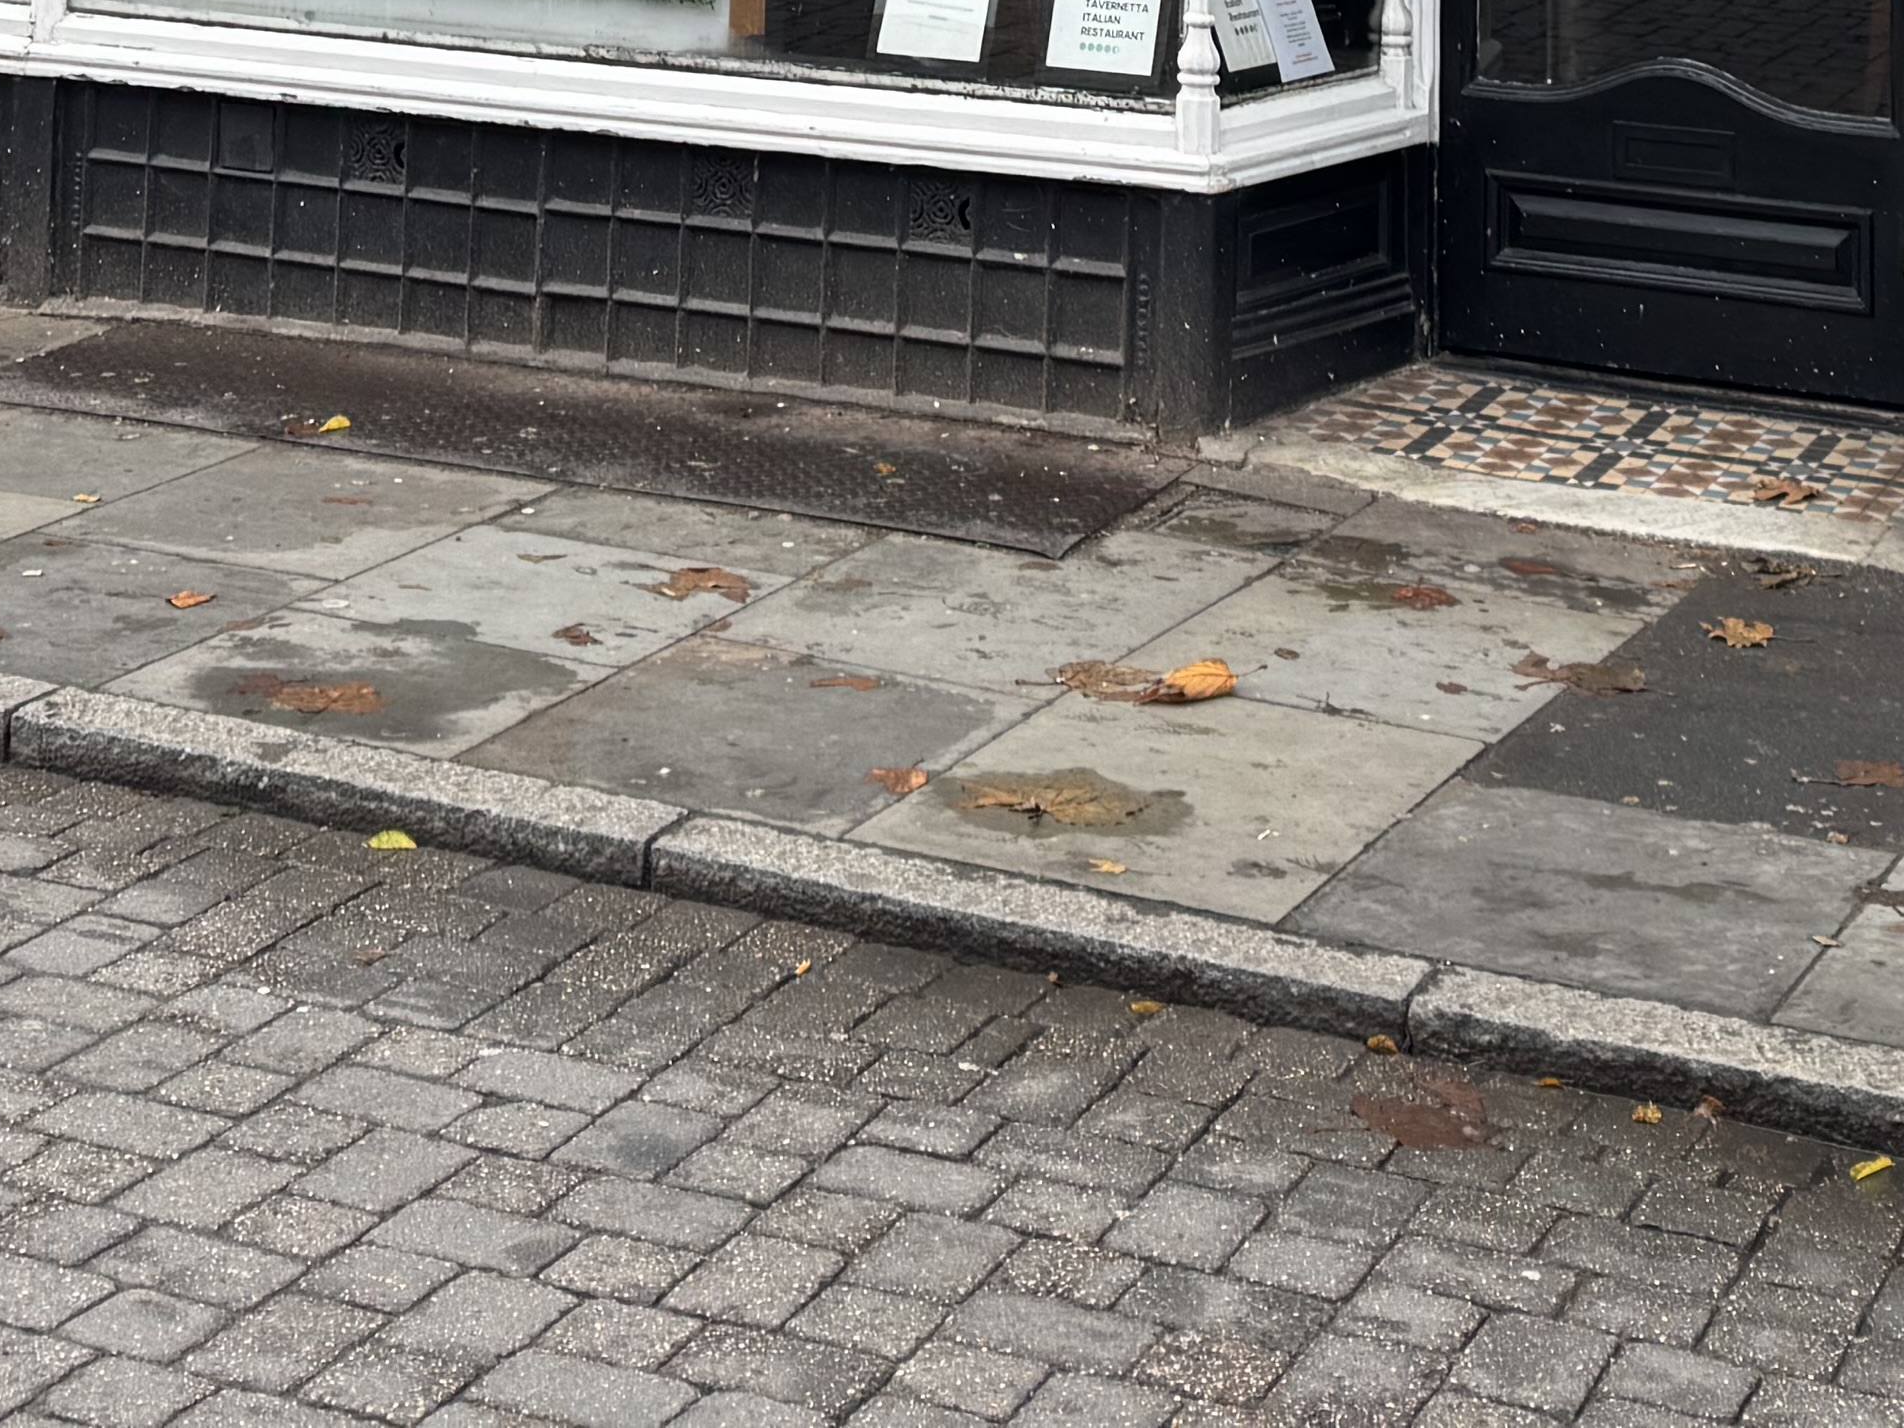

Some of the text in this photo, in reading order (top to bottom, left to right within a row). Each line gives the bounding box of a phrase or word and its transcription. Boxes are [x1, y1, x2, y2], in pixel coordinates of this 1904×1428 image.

[1085, 0, 1149, 13] TAVERNETTA
[1082, 12, 1121, 25] ITALIAN
[1080, 26, 1145, 41] RESTAURANT
